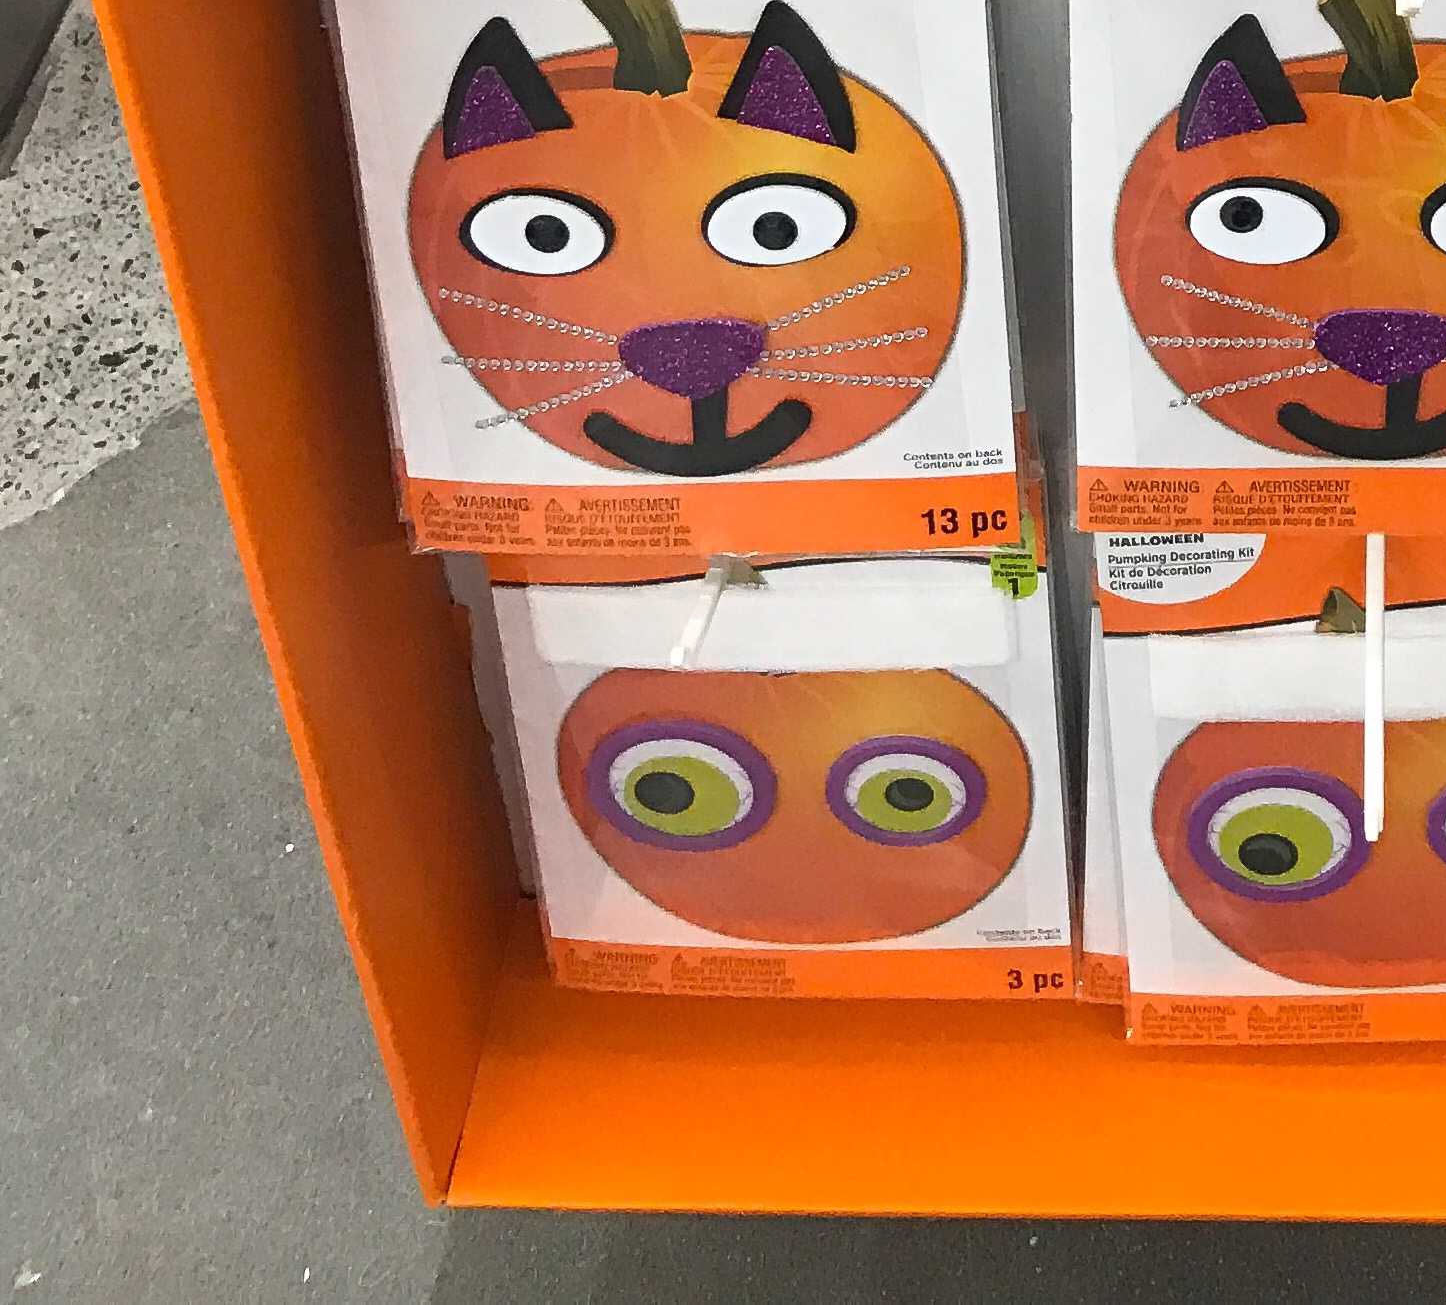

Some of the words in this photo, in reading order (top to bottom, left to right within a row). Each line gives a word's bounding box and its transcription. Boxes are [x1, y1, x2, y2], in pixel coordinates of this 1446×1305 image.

[921, 508, 959, 535] 13
[972, 510, 1007, 538] pc
[1109, 534, 1204, 547] HALLOWEEN
[1007, 969, 1024, 989] 3
[1034, 971, 1064, 993] pc
